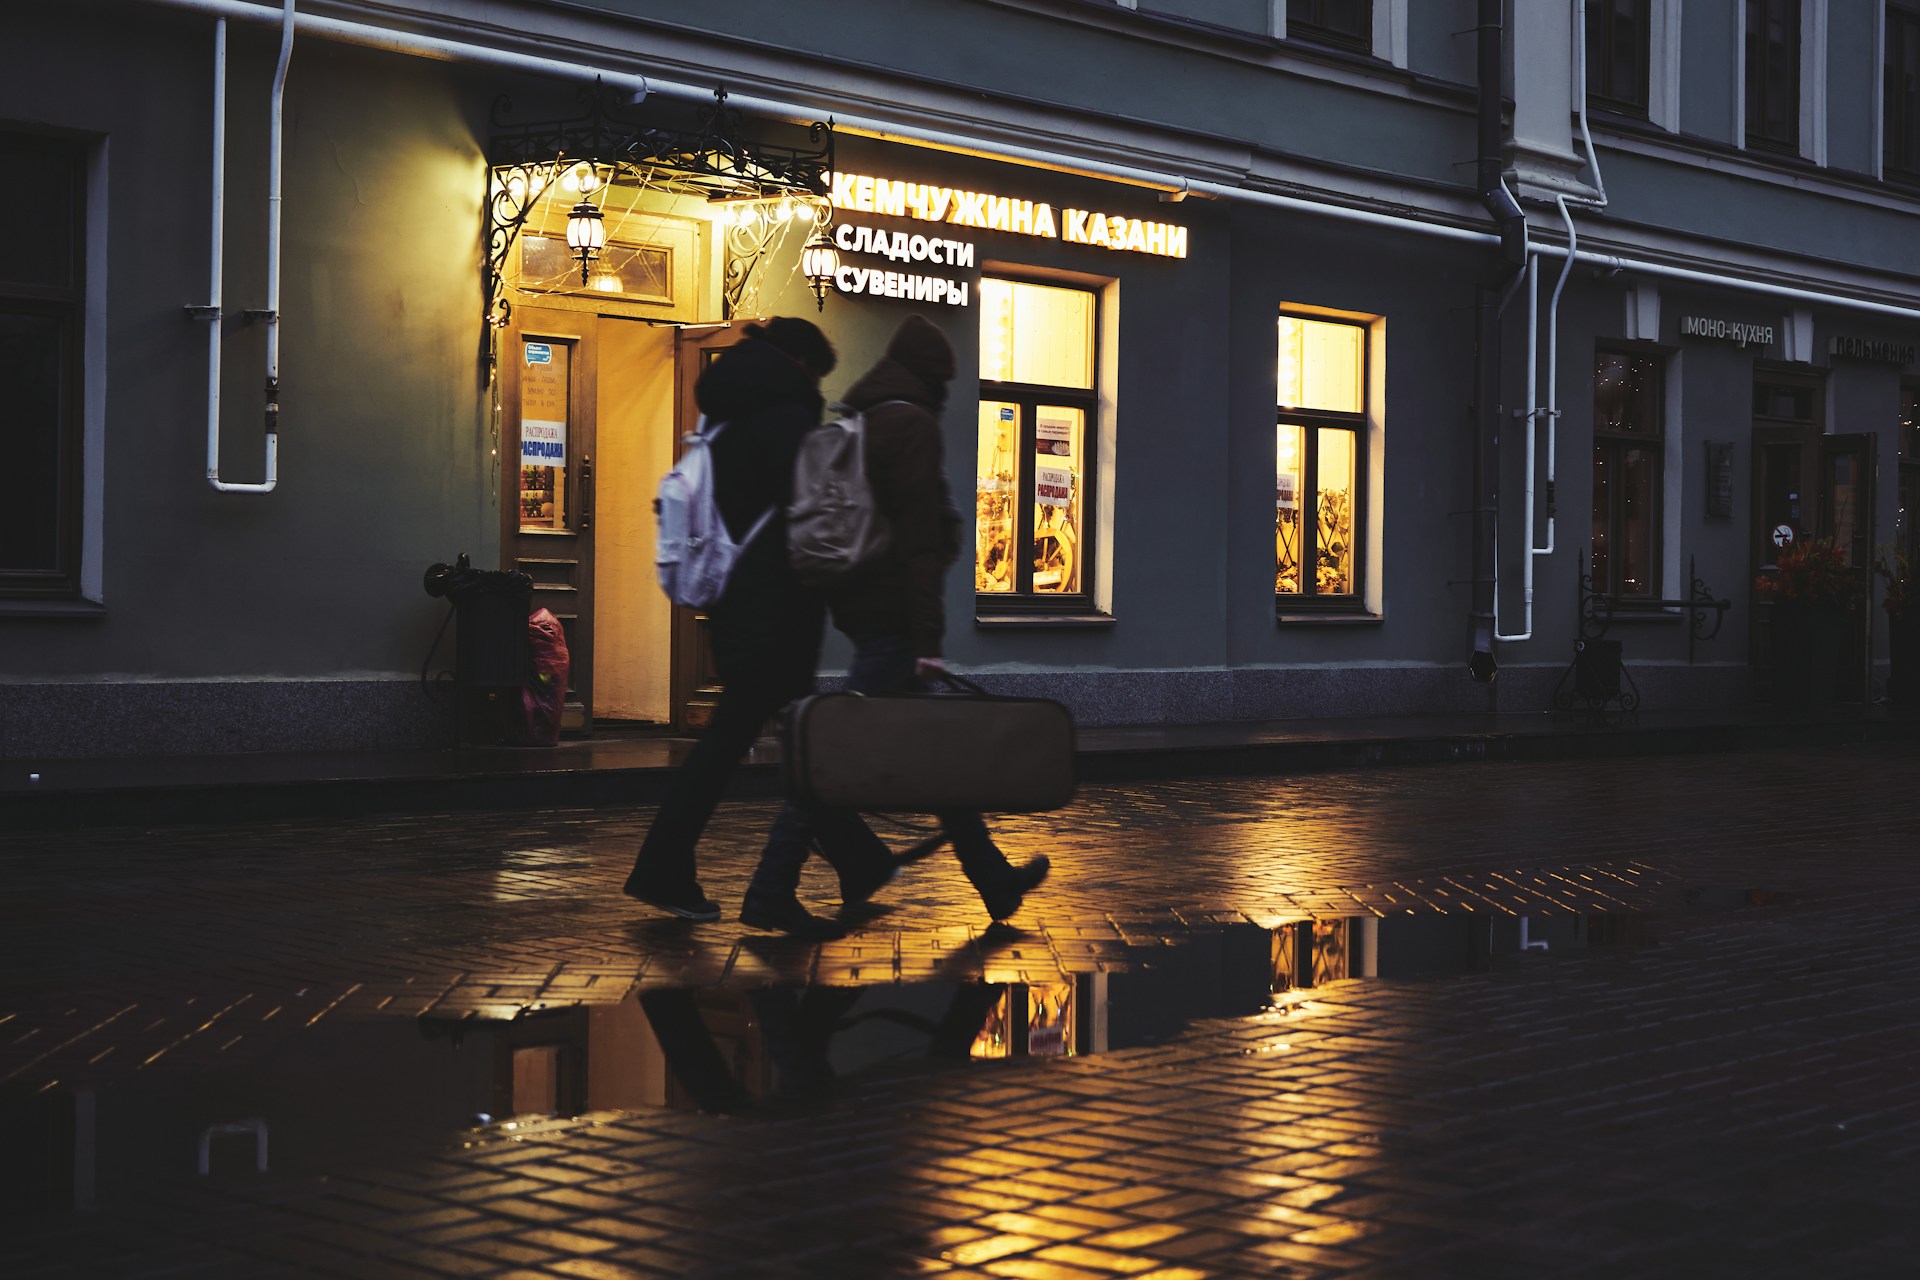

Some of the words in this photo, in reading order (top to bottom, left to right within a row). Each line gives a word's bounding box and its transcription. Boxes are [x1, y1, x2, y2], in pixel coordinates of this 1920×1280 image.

[836, 223, 974, 268] СЛАДОСТИ
[1062, 208, 1188, 259] КАЗАНИ
[836, 265, 968, 307] СУВЕНИРЫ
